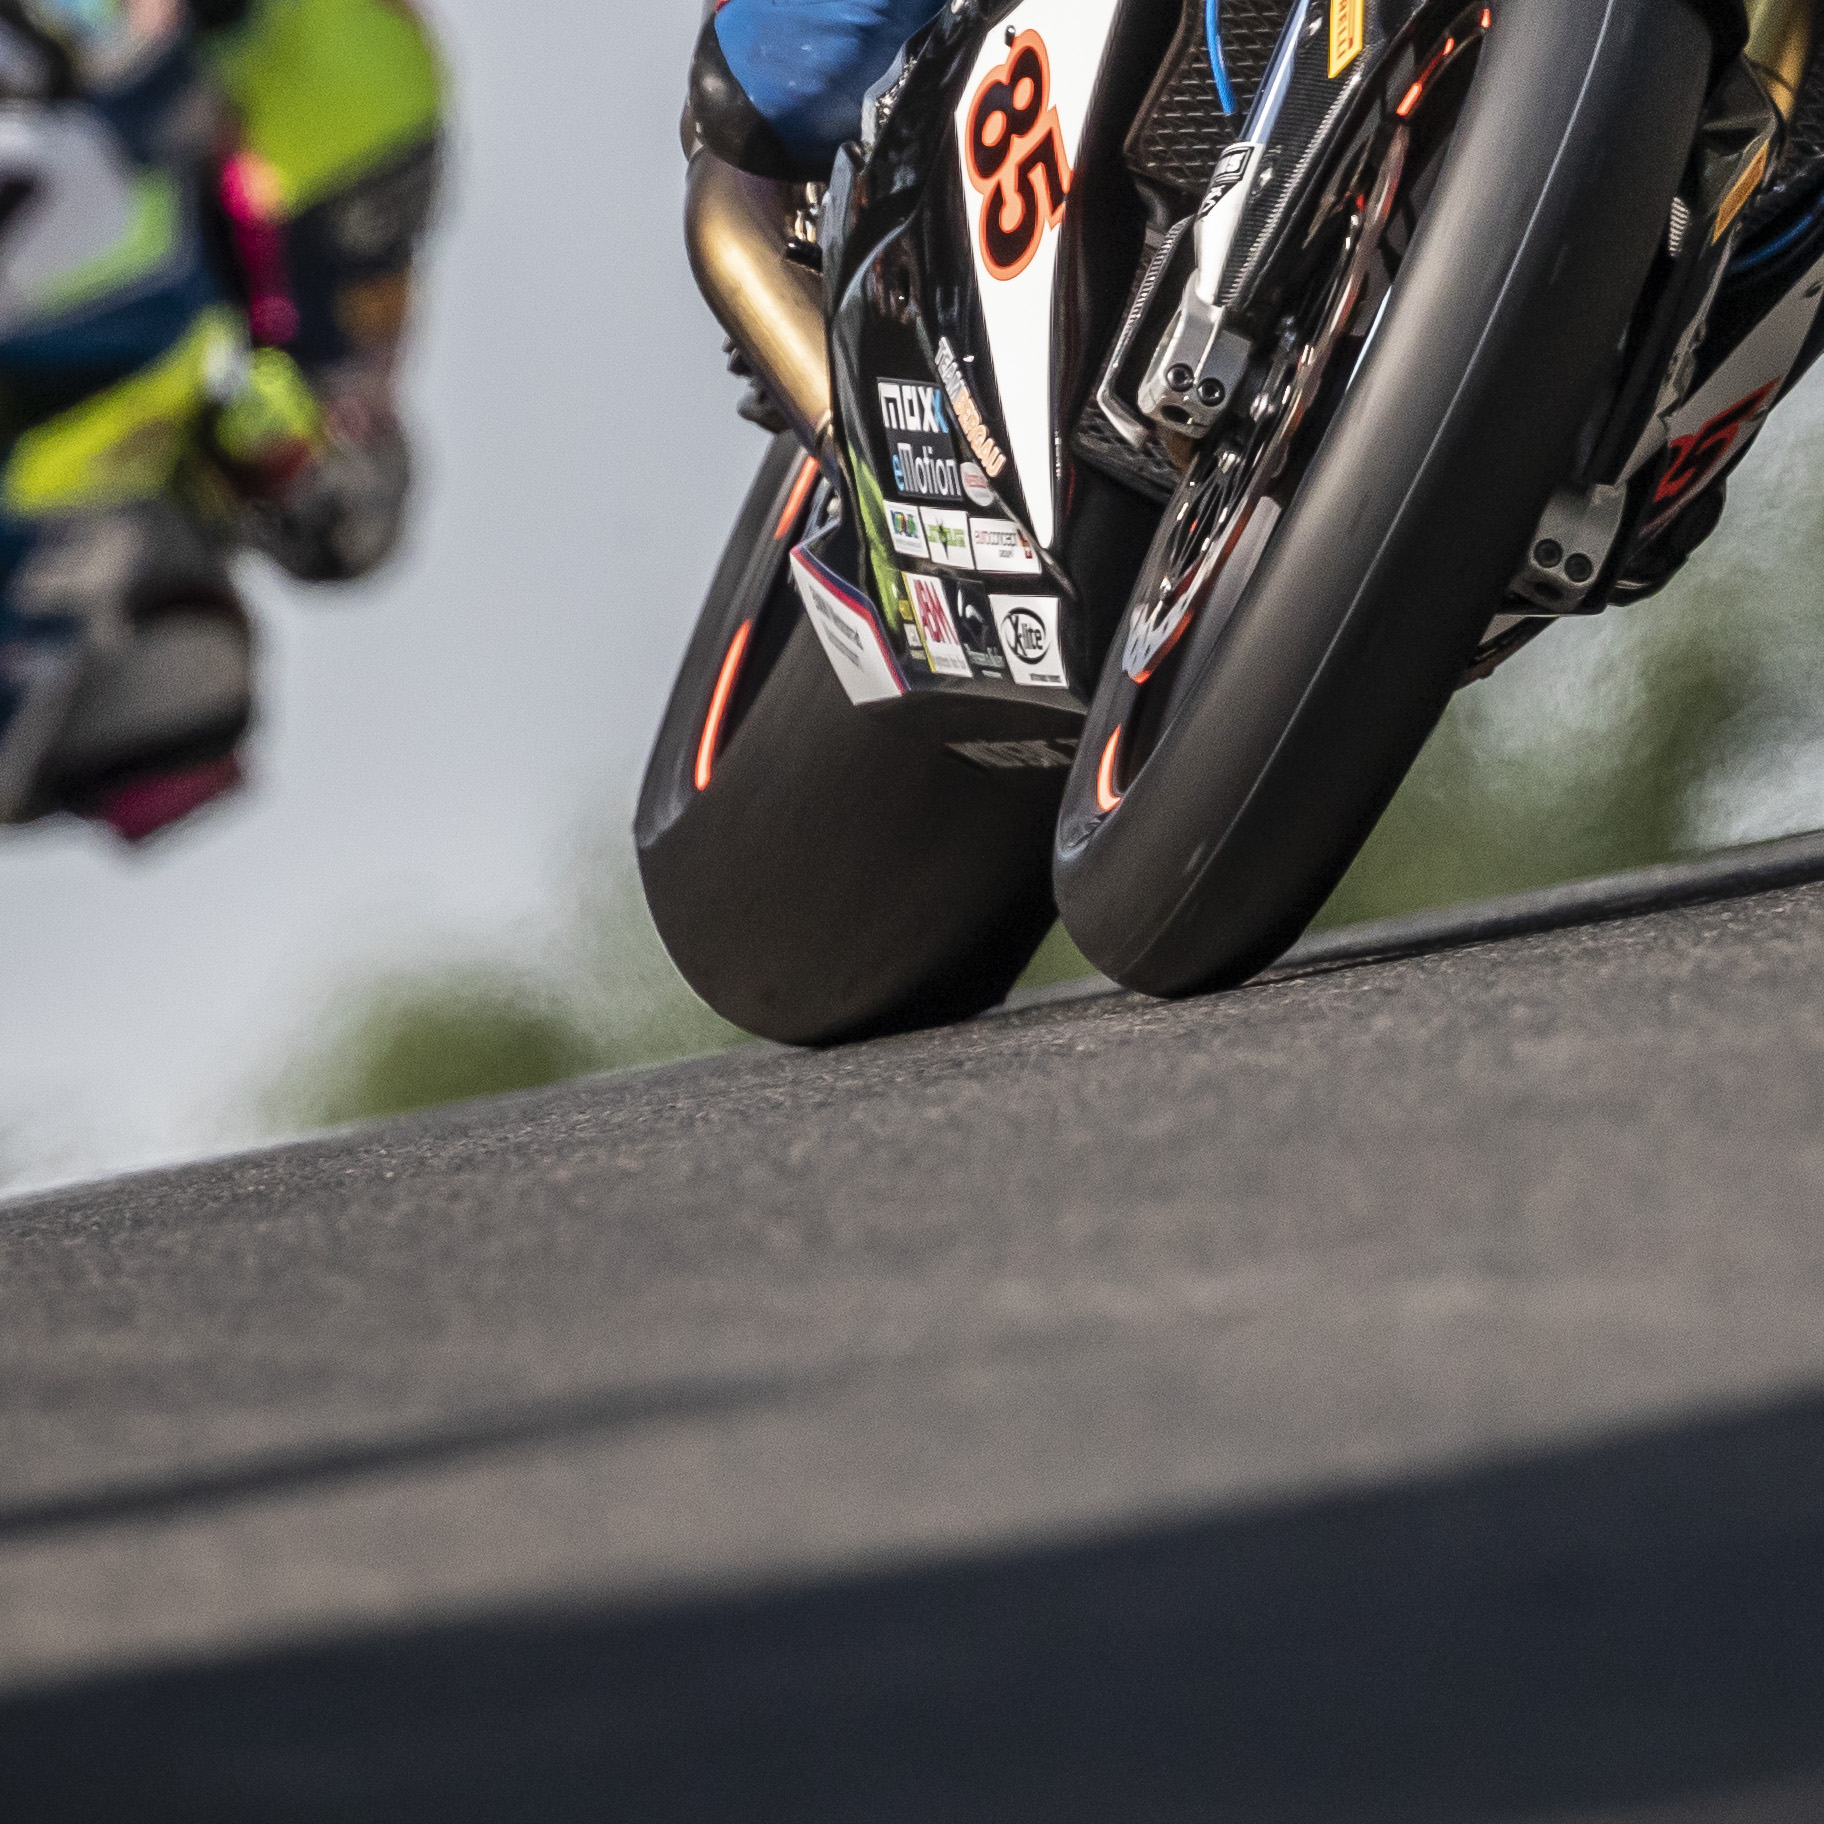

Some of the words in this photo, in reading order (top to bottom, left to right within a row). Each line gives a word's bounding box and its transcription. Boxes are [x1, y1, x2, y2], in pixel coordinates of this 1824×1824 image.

[965, 28, 1075, 281] 85
[878, 382, 949, 434] maxx
[952, 386, 1007, 477] BERGAU
[892, 442, 962, 497] eMotion
[1004, 613, 1044, 657] X-lite
